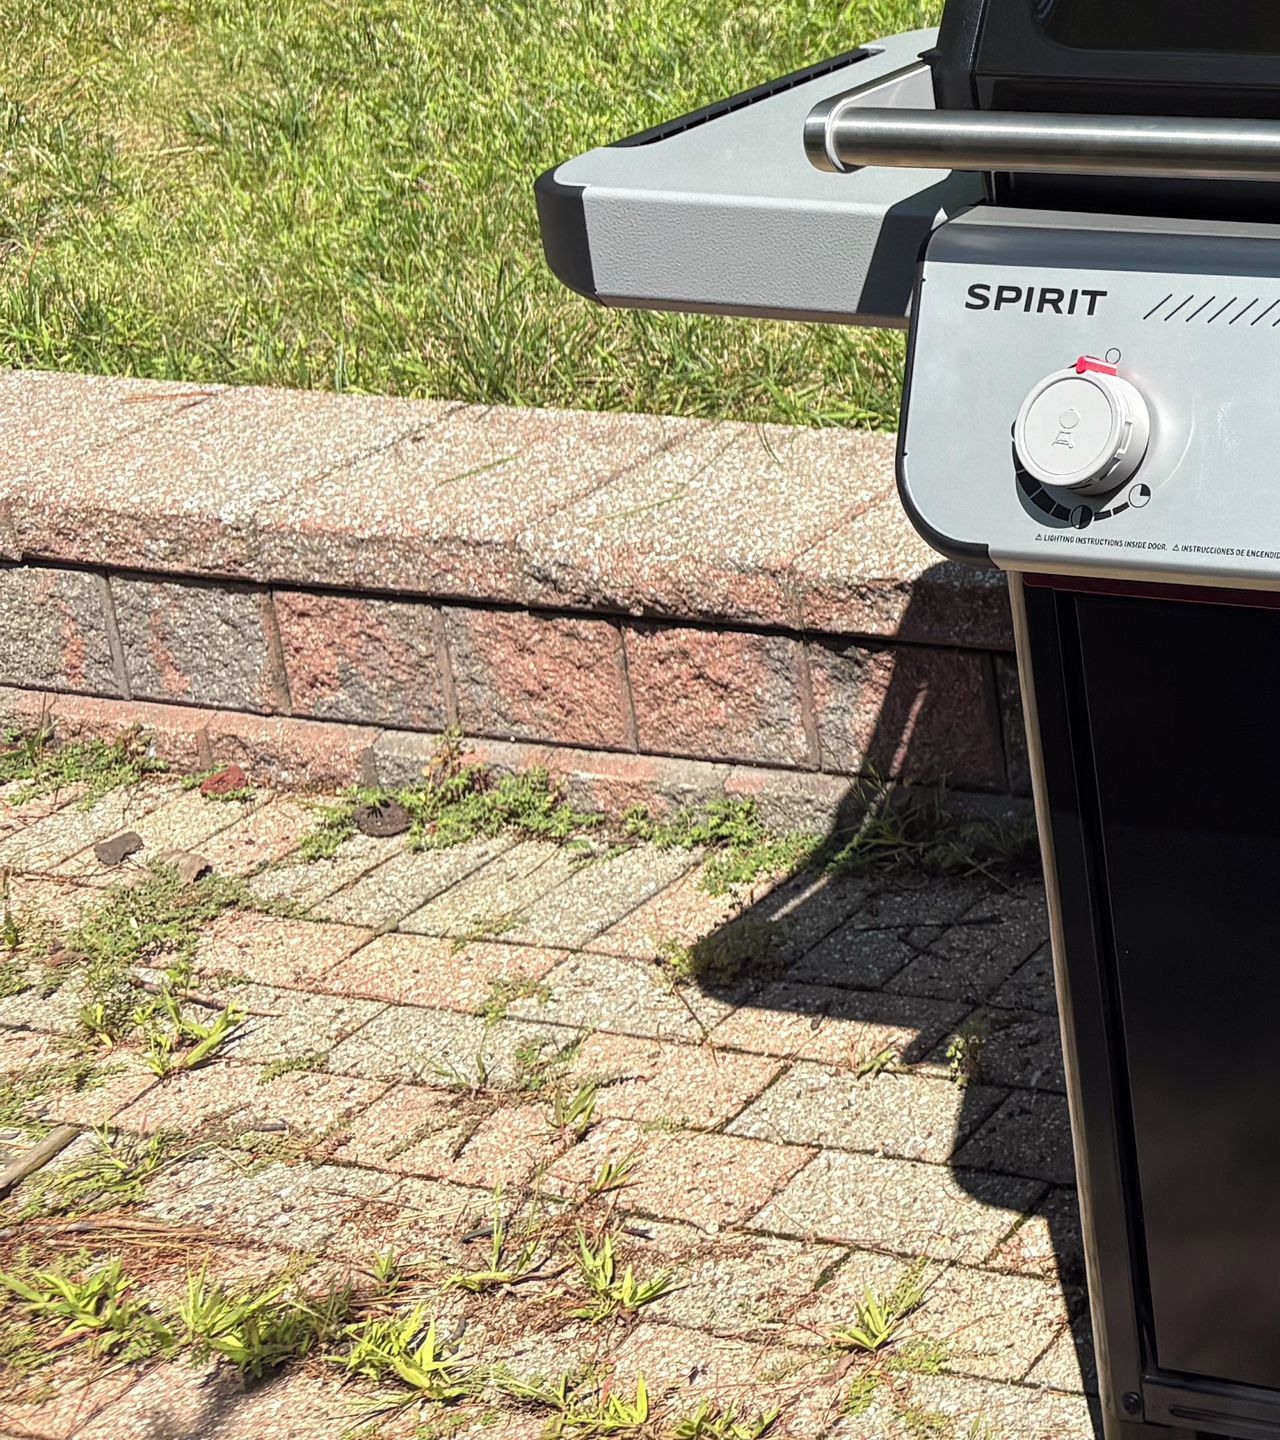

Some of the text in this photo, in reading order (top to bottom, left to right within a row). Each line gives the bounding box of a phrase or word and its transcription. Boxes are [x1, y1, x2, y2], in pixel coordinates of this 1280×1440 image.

[965, 283, 1107, 316] SPIRIT
[1043, 534, 1074, 544] LIGHTING
[1075, 537, 1123, 548] INSTRUCTIONS
[1124, 540, 1147, 549] INSIDE
[1181, 545, 1235, 556] INSTRUCCIONES
[1235, 548, 1245, 557] DE
